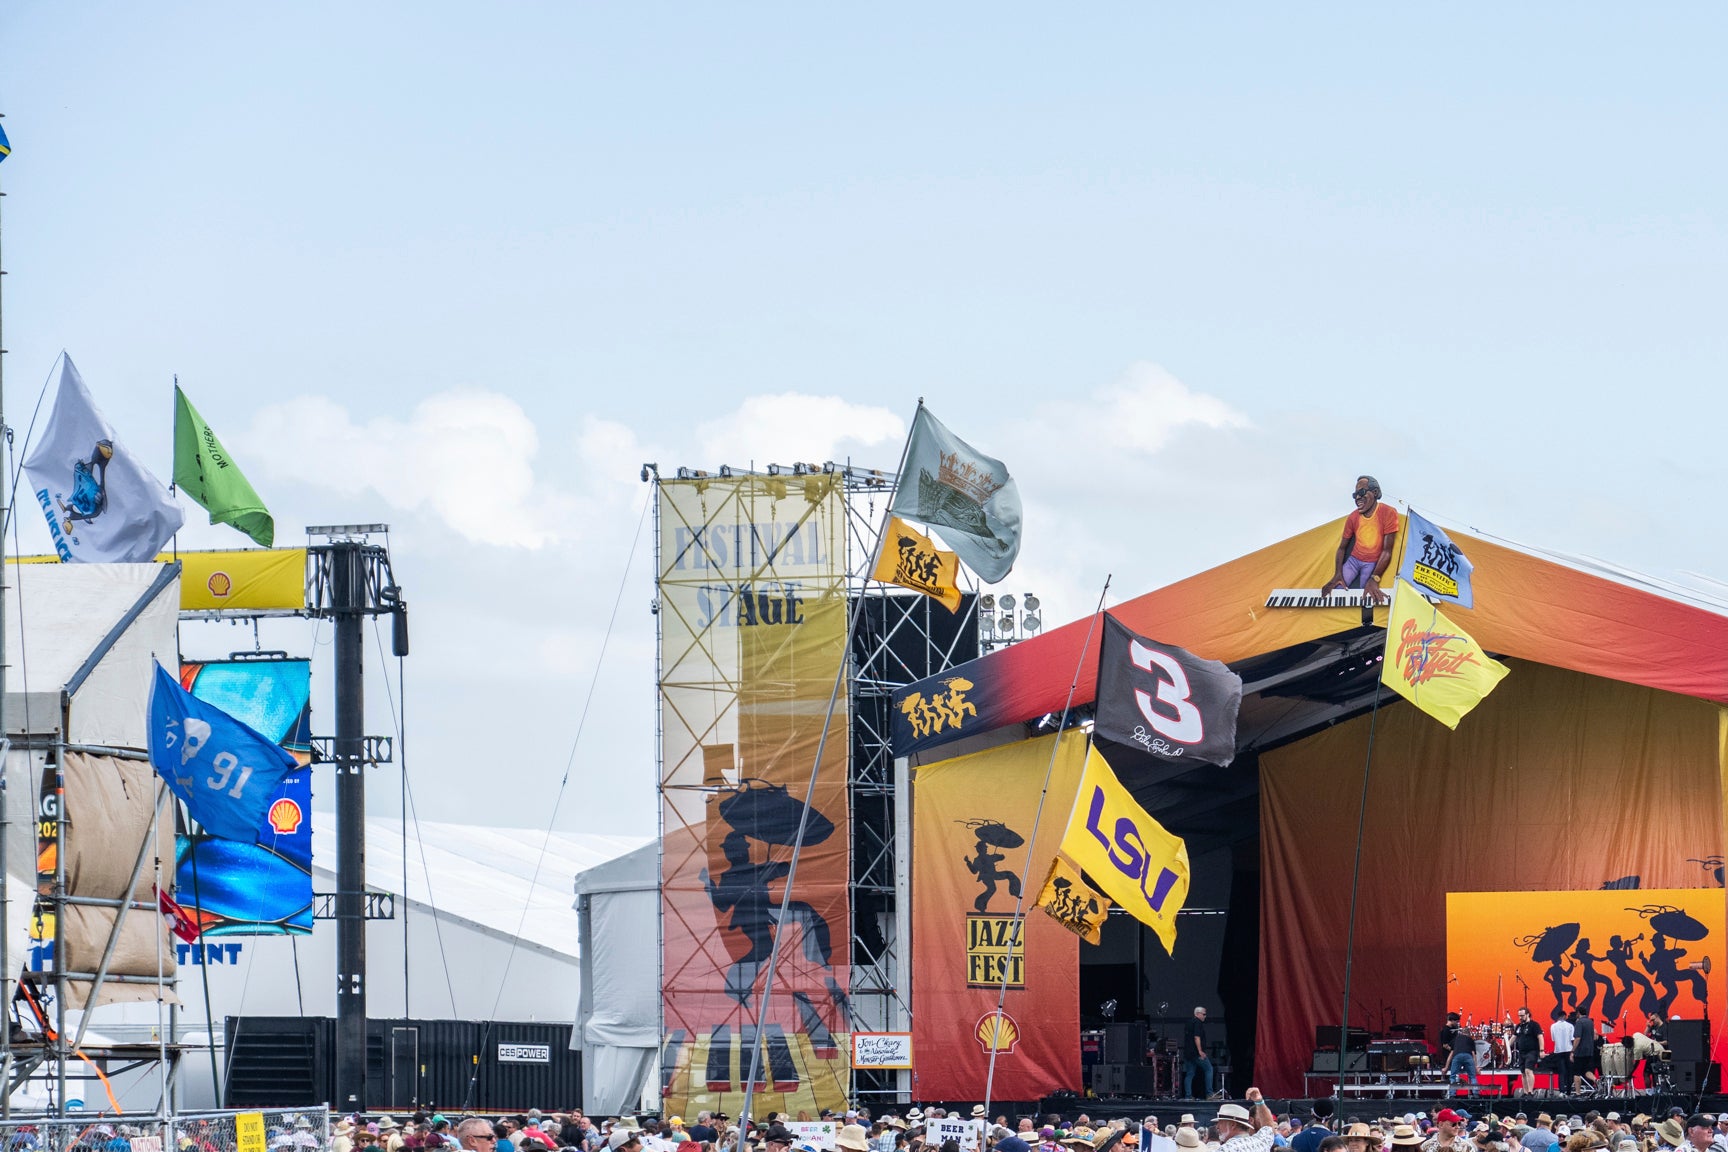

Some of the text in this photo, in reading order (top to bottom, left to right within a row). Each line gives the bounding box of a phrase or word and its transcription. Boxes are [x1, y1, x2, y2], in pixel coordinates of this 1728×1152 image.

[674, 521, 827, 571] FESTIVAL
[697, 580, 805, 629] STAGE
[1130, 638, 1205, 745] 3
[207, 751, 253, 800] 91
[1086, 784, 1180, 913] LSU
[176, 943, 242, 965] TENT
[968, 919, 1024, 952] JAZZ
[968, 954, 1024, 984] FEST
[500, 1048, 547, 1058] CES POWER
[941, 1124, 964, 1133] BEER
